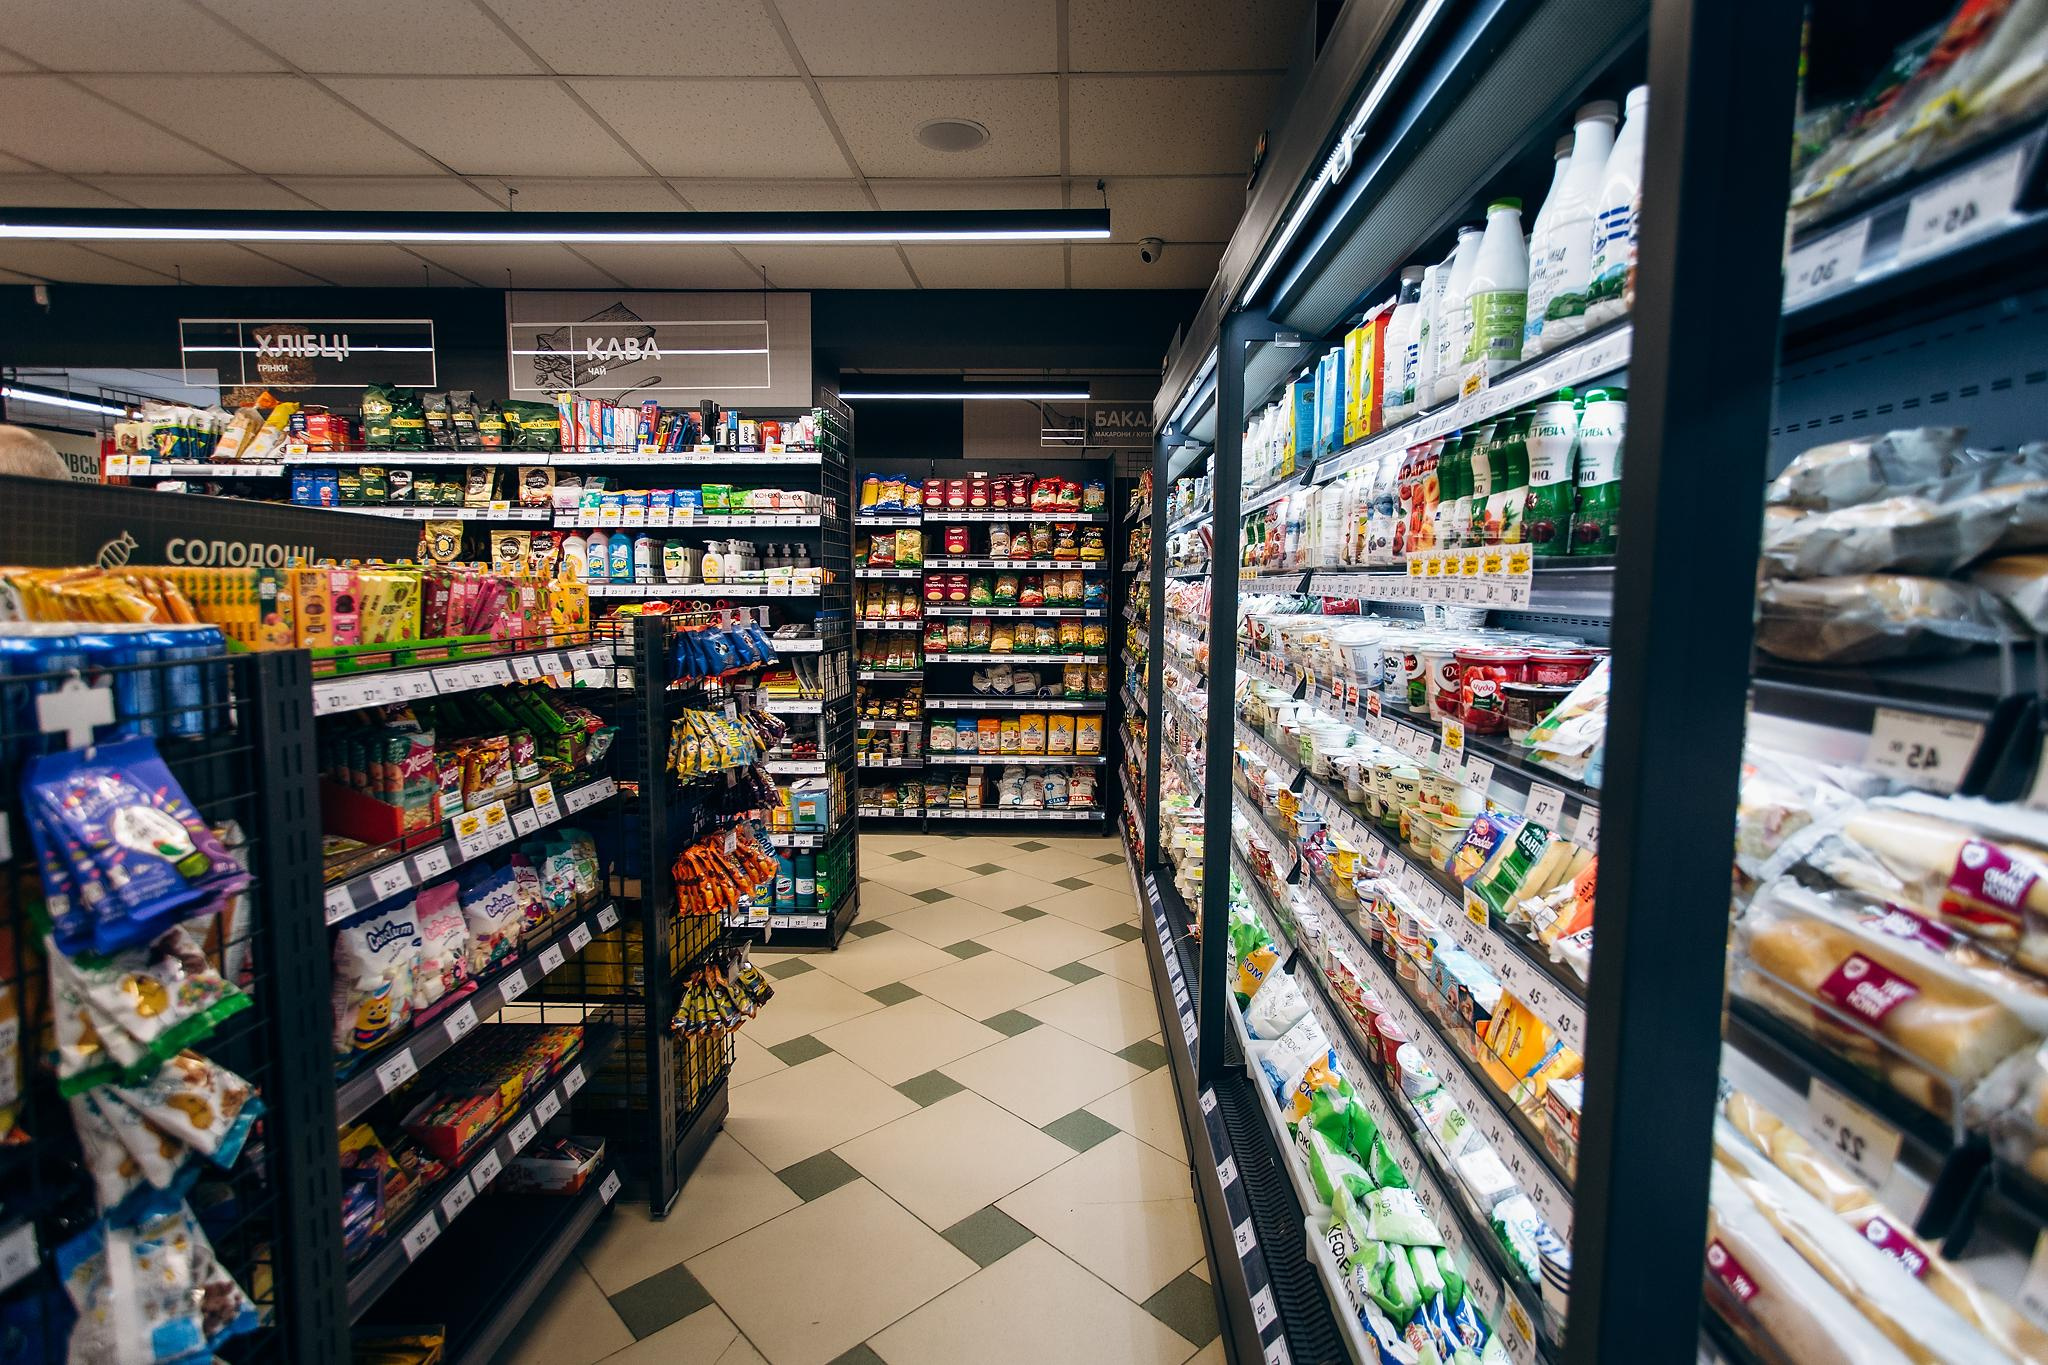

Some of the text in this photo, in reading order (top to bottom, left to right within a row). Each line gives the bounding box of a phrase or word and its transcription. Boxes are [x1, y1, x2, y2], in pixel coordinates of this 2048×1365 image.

[255, 334, 349, 361] ХЛІБЦІ
[586, 337, 661, 360] КАВА
[258, 364, 288, 372] ГРІНКИ
[588, 366, 606, 375] ЧАЙ
[593, 402, 601, 434] Colgate
[390, 475, 411, 483] Paloma
[300, 572, 318, 585] BOB
[331, 572, 349, 585] BOB
[261, 582, 277, 594] BOB
[1472, 682, 1495, 694] Чудо
[1467, 833, 1495, 850] Cheddar
[1449, 1108, 1466, 1129] СИР
